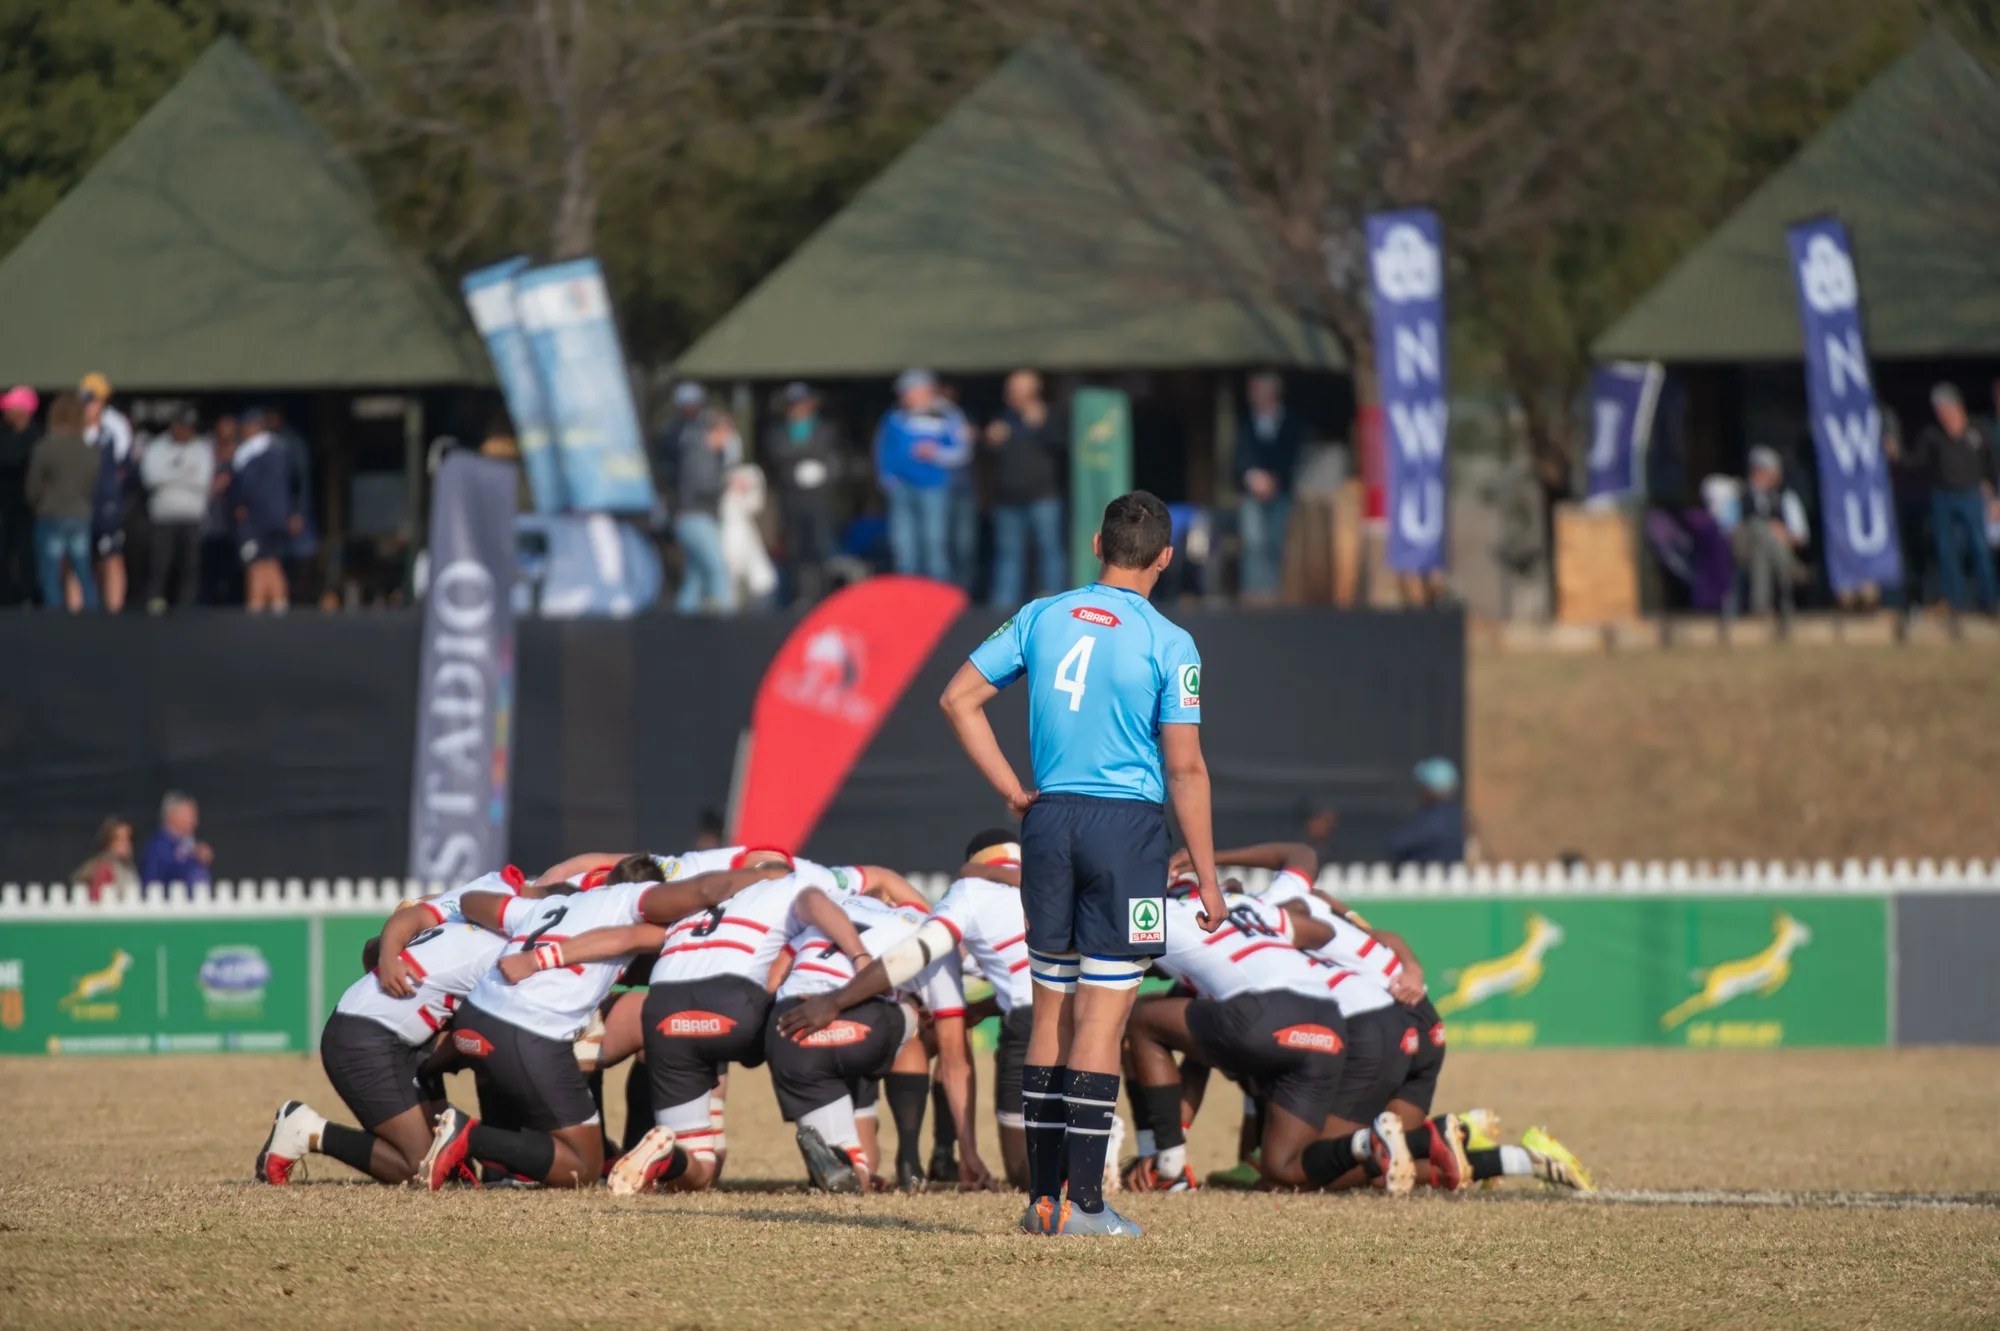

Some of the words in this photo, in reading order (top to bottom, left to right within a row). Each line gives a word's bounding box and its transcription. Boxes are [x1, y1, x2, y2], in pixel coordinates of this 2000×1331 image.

[1389, 317, 1448, 547] NWU
[1824, 325, 1888, 556] NWU
[1079, 608, 1114, 626] OBARO
[1054, 635, 1096, 712] 4
[421, 559, 494, 881] STADIO
[520, 905, 569, 951] 2
[1133, 932, 1161, 941] SPAR
[671, 1018, 720, 1033] OBARO
[1288, 1030, 1334, 1050] OBARO
